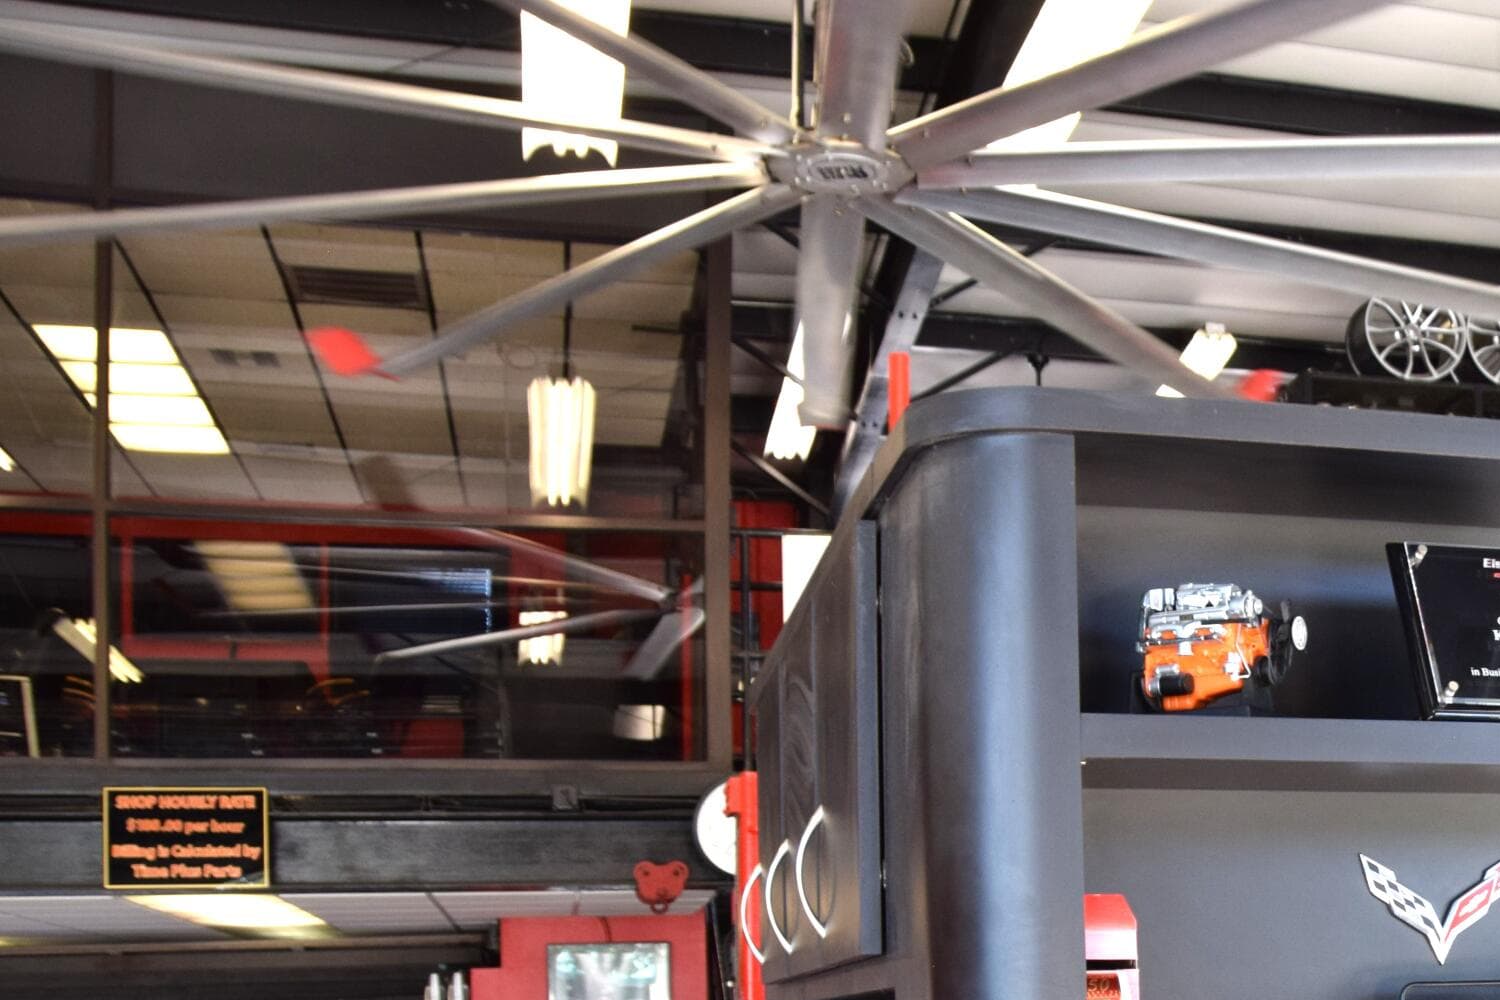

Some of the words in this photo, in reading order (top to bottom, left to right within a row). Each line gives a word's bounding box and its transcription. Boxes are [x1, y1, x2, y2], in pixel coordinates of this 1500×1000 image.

[1471, 667, 1480, 677] in
[115, 795, 157, 810] SHOP
[158, 795, 218, 810] HOURLY
[219, 795, 256, 809] RATE
[210, 818, 245, 833] hour
